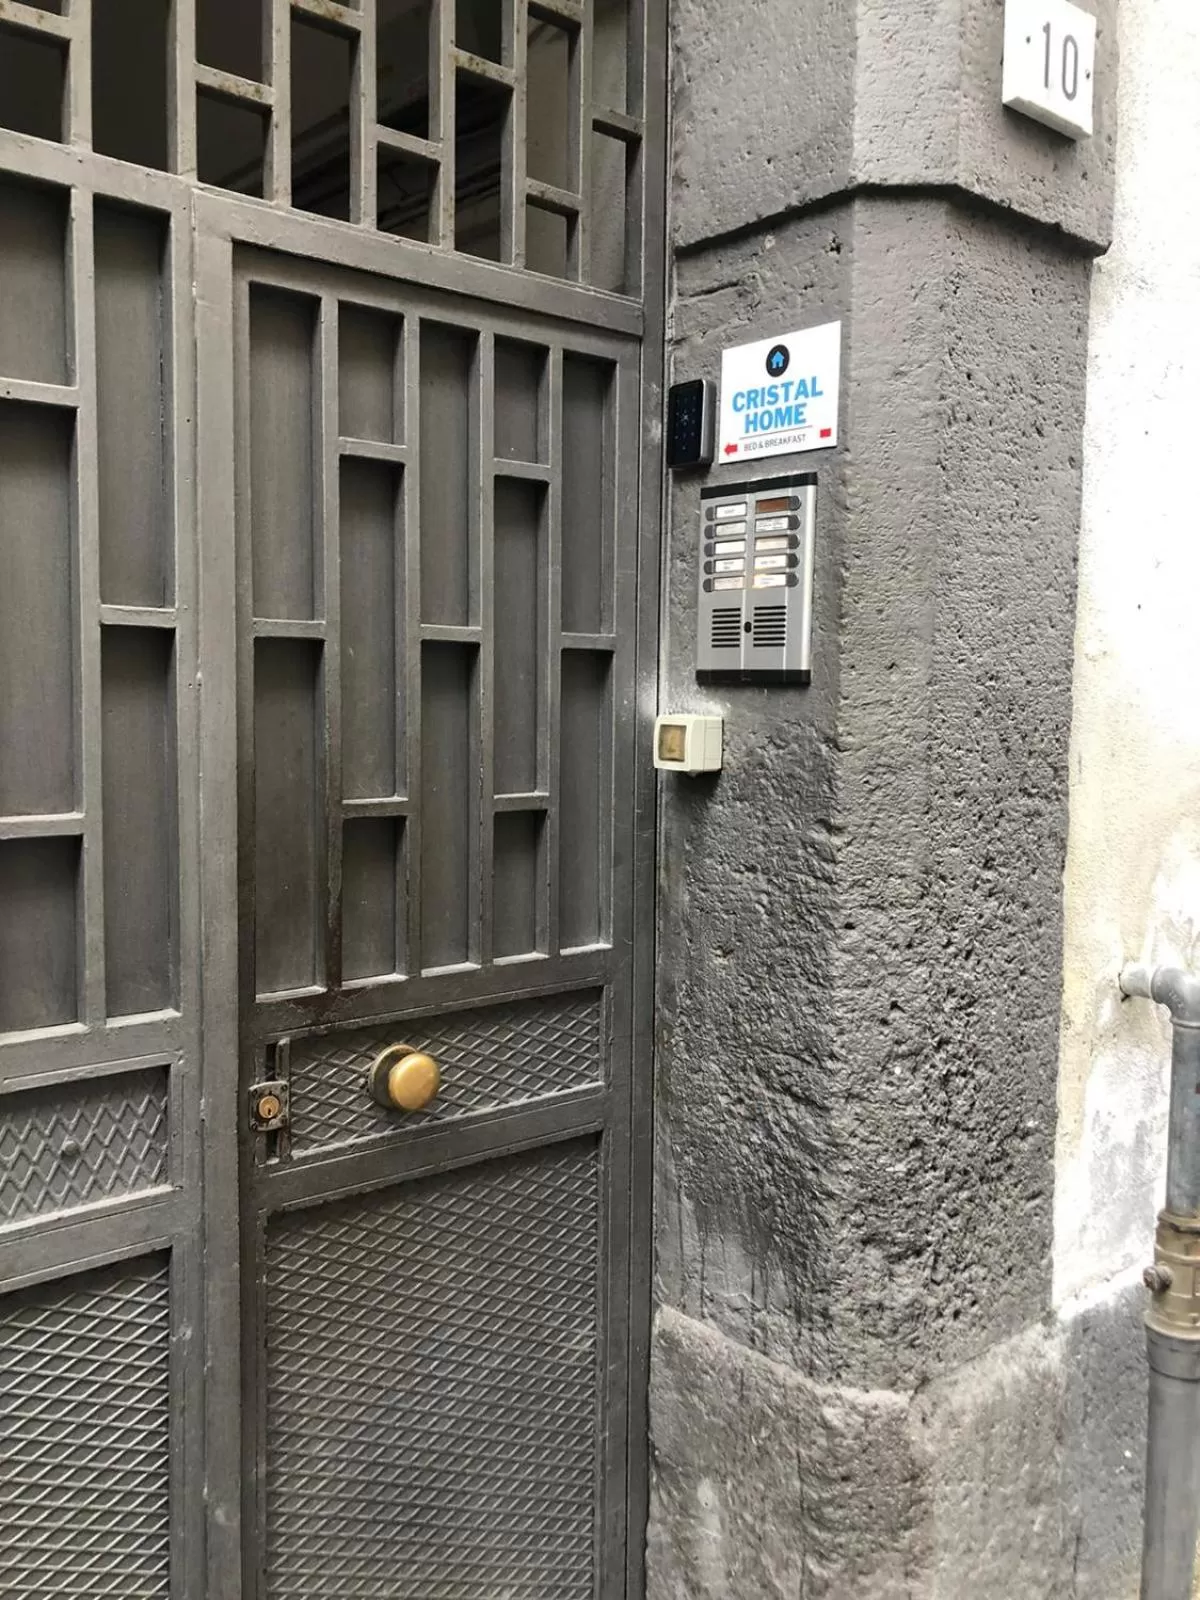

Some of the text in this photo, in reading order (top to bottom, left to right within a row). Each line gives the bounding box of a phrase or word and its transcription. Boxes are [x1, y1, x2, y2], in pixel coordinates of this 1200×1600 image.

[1042, 21, 1078, 100] 10
[732, 376, 823, 412] CRISTAL
[744, 402, 807, 434] HOME
[743, 433, 806, 452] BED & BREAKFAST
